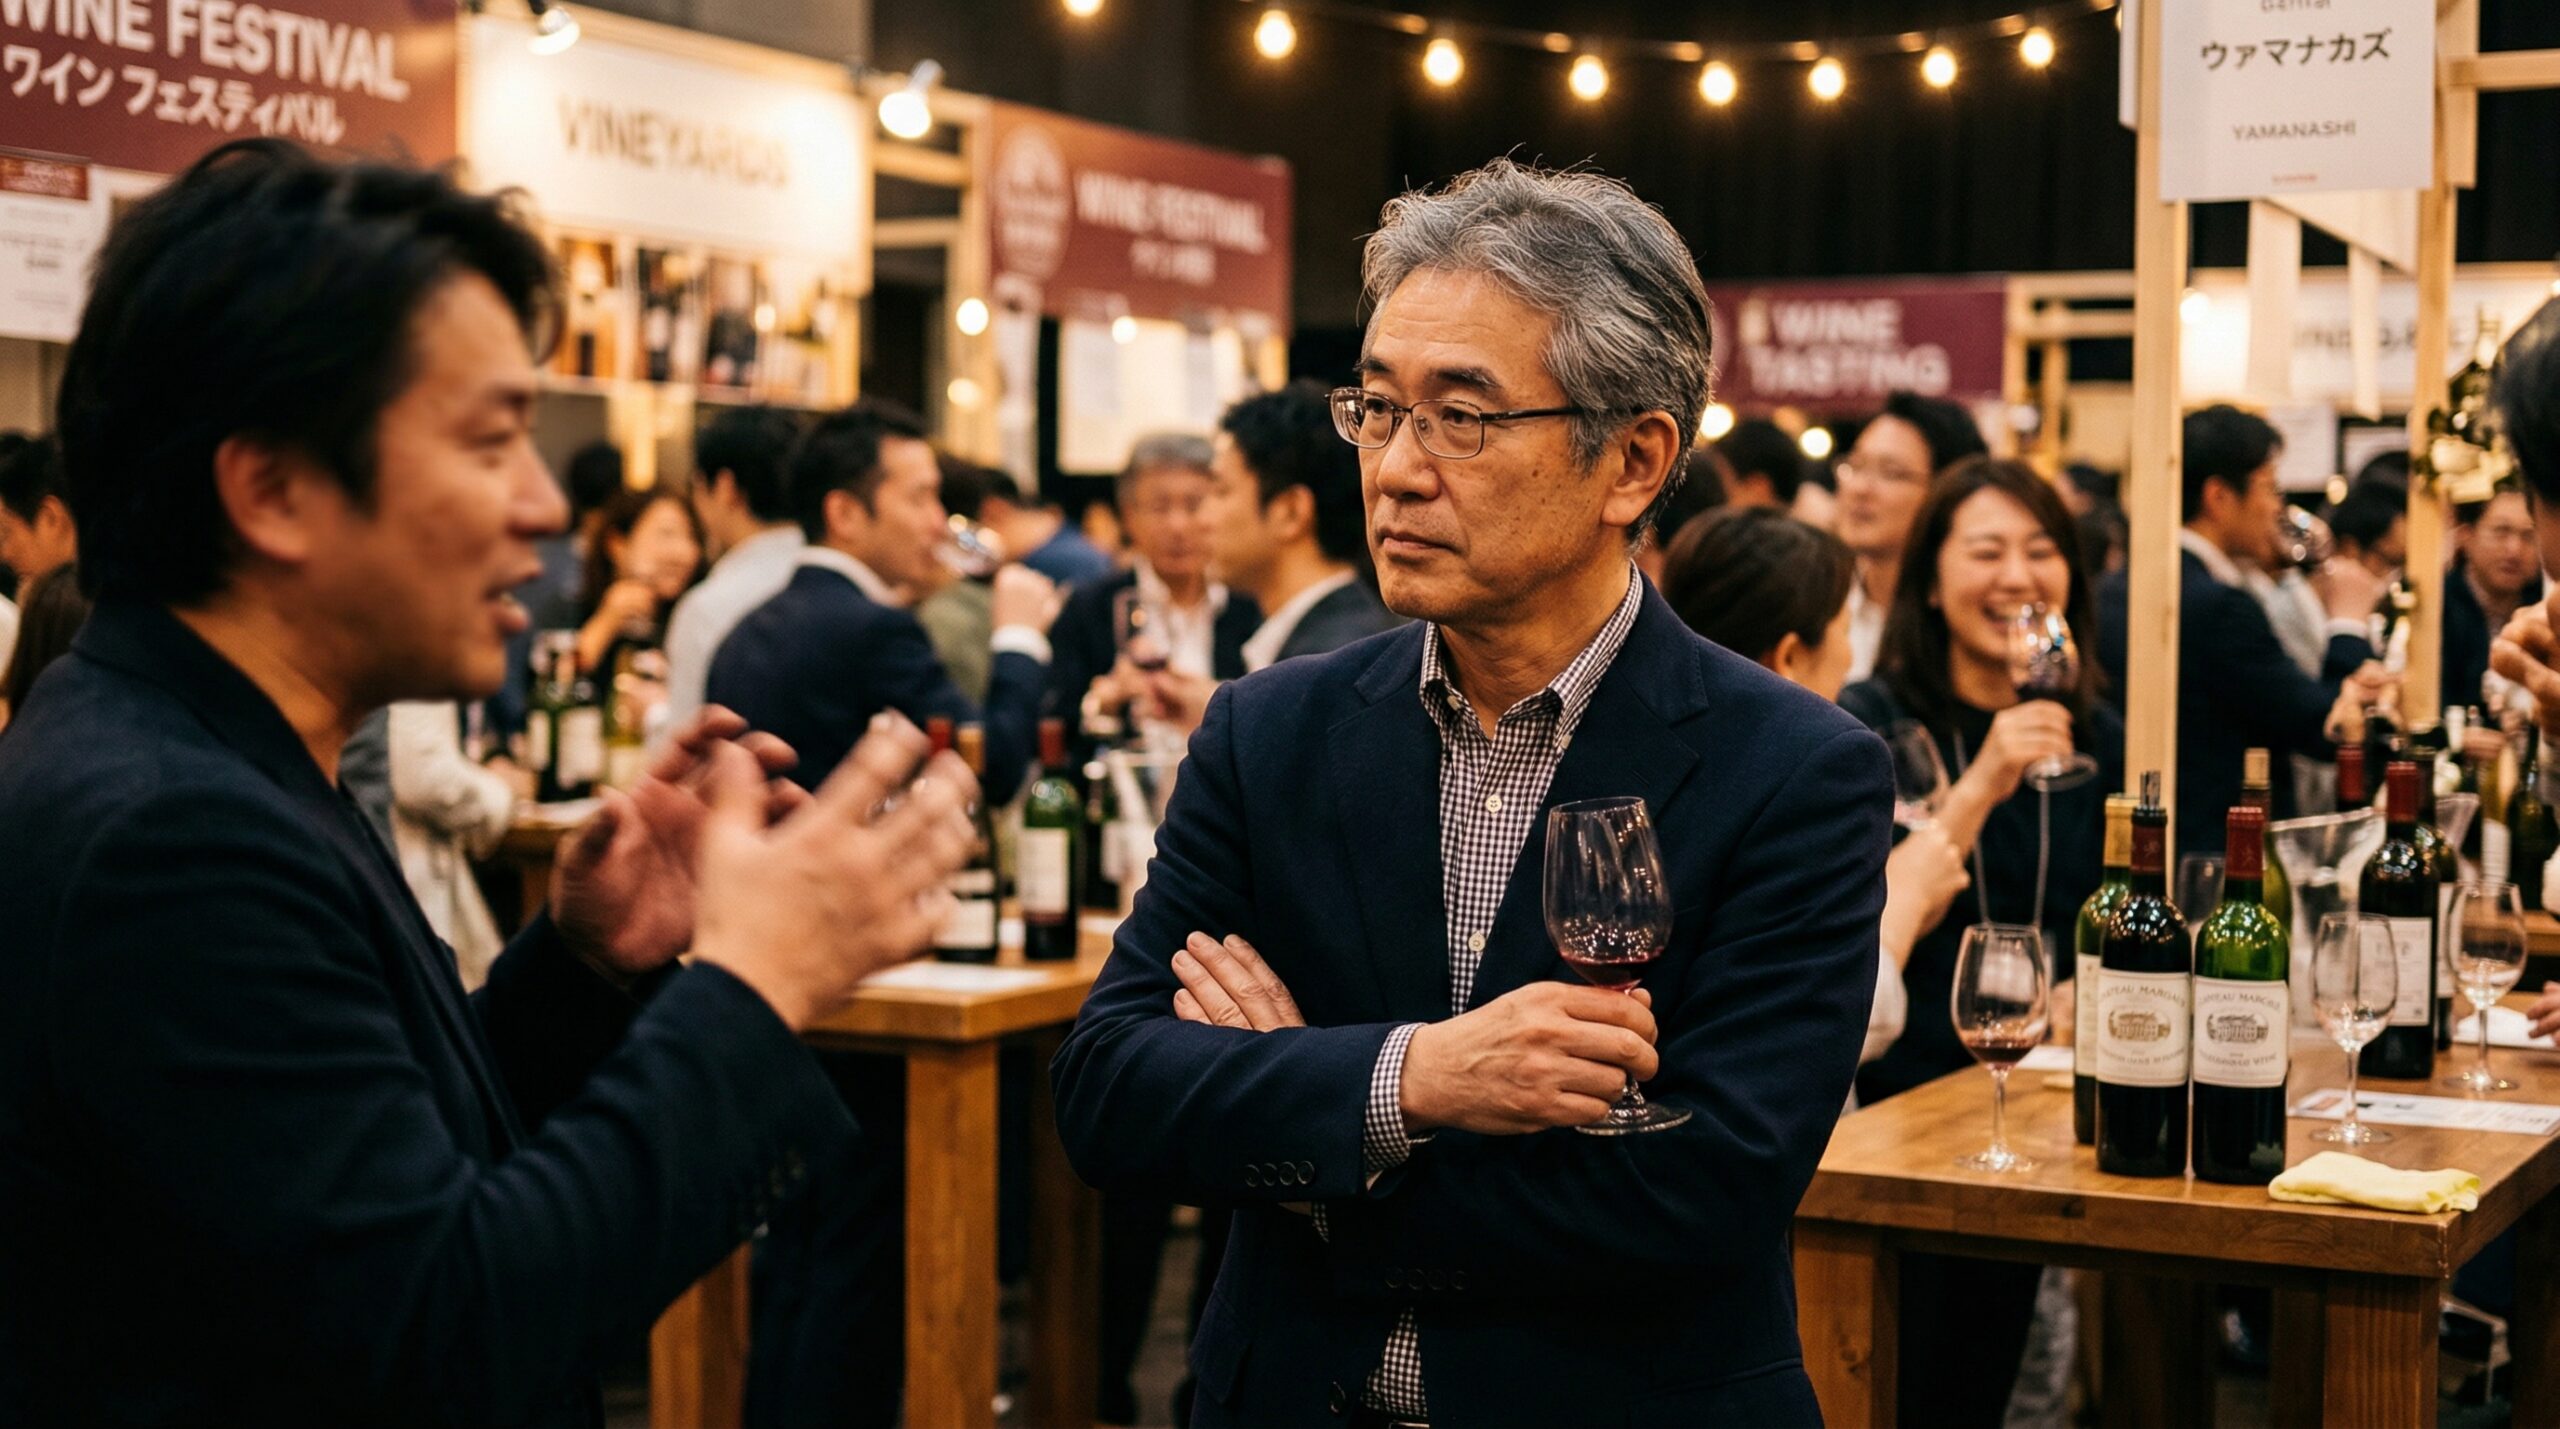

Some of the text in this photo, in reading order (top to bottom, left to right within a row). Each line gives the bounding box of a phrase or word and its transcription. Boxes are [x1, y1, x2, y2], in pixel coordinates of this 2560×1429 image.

[167, 0, 411, 101] FESTIVAL
[2231, 119, 2357, 141] YAMANASHI
[1772, 298, 1899, 345] WINE
[1749, 344, 1950, 398] TASTING
